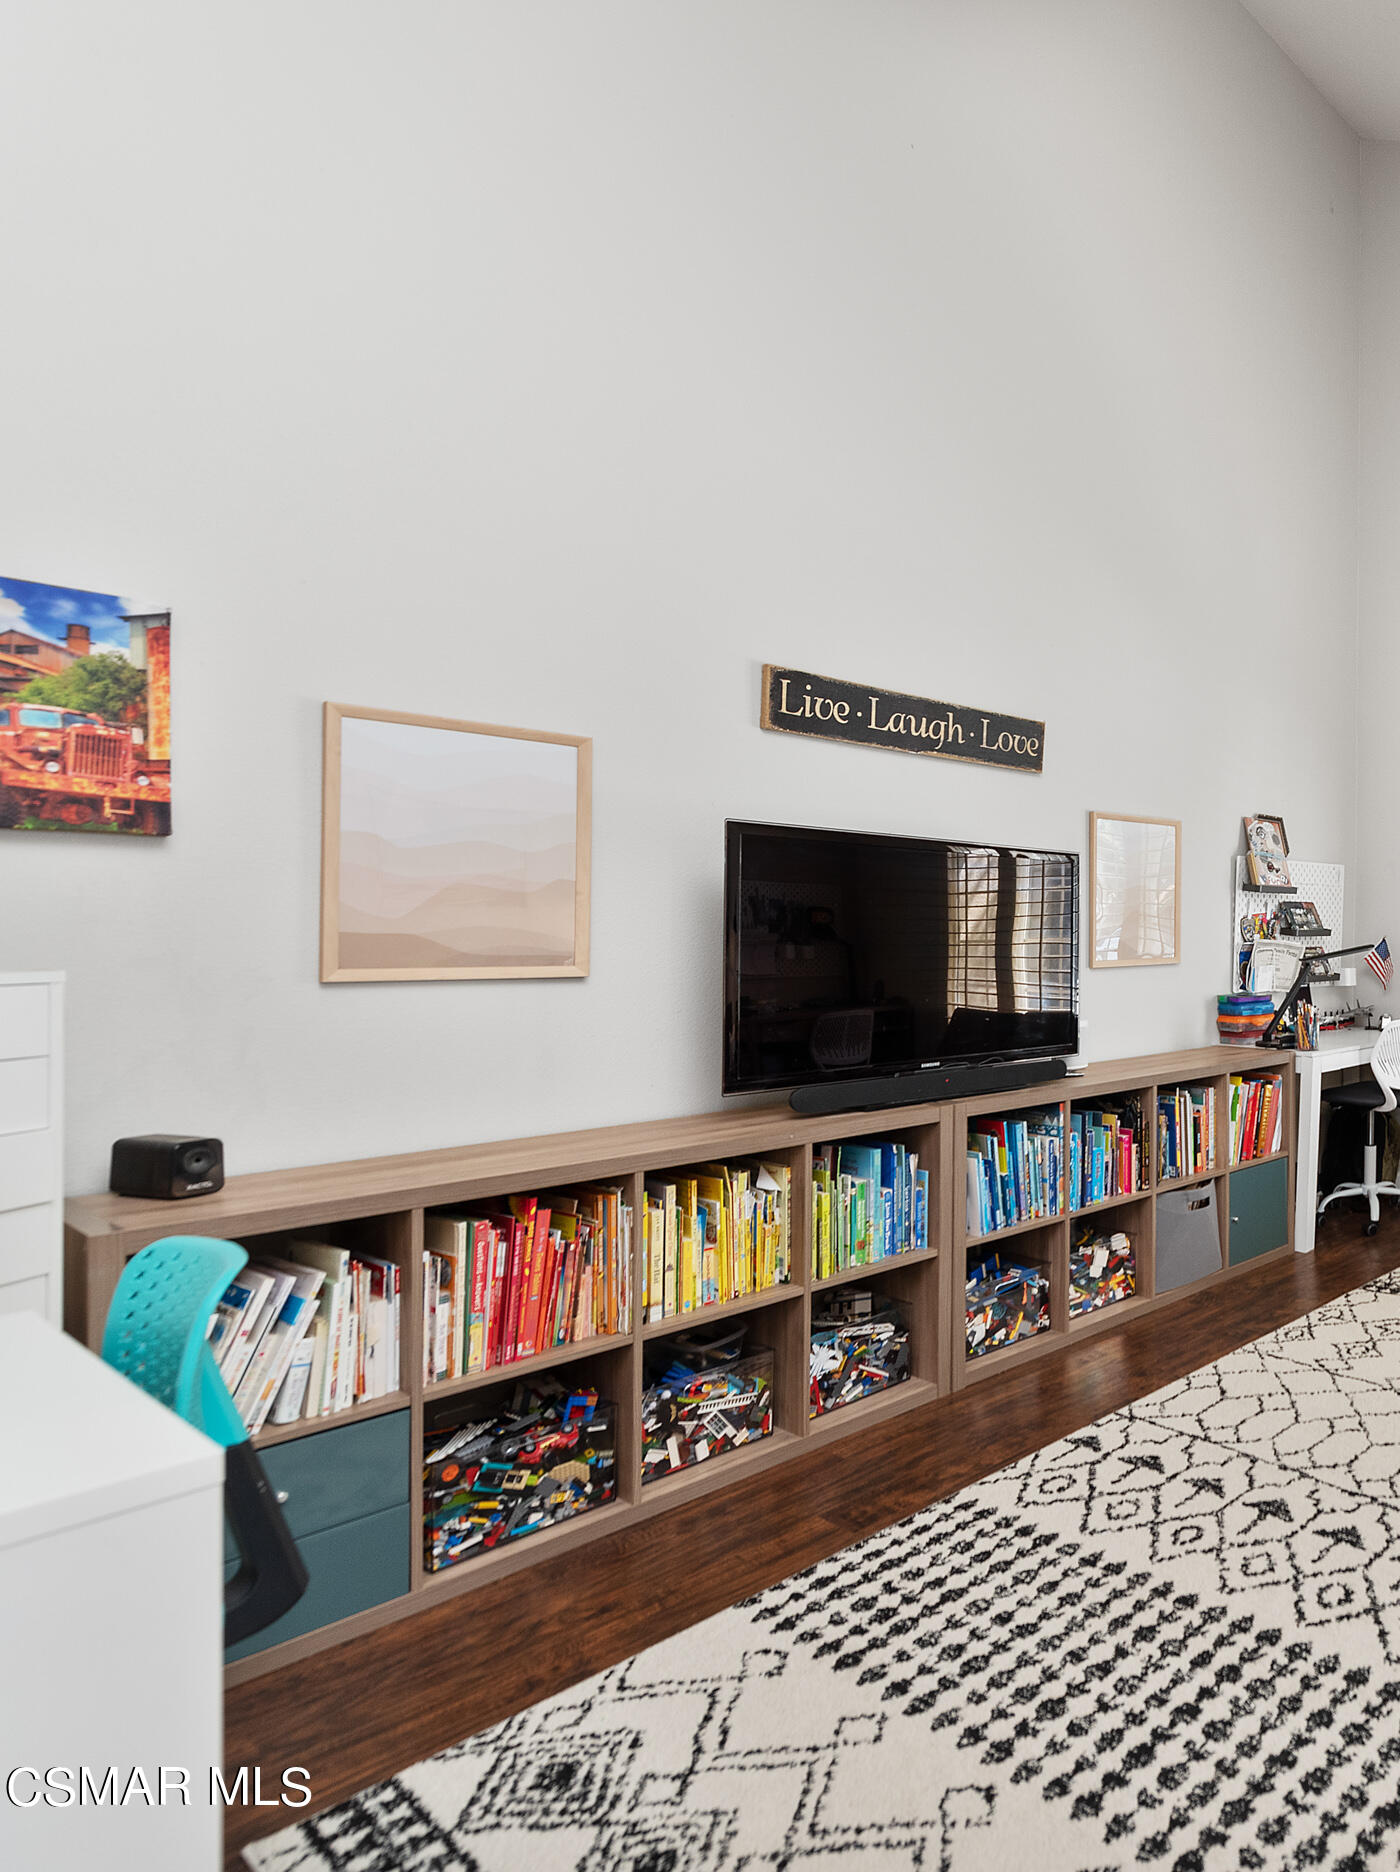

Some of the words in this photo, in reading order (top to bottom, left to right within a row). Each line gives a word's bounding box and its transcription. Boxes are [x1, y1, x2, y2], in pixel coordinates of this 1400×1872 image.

[778, 678, 850, 724] Live
[867, 696, 966, 750] Laugh
[979, 718, 1040, 757] Love
